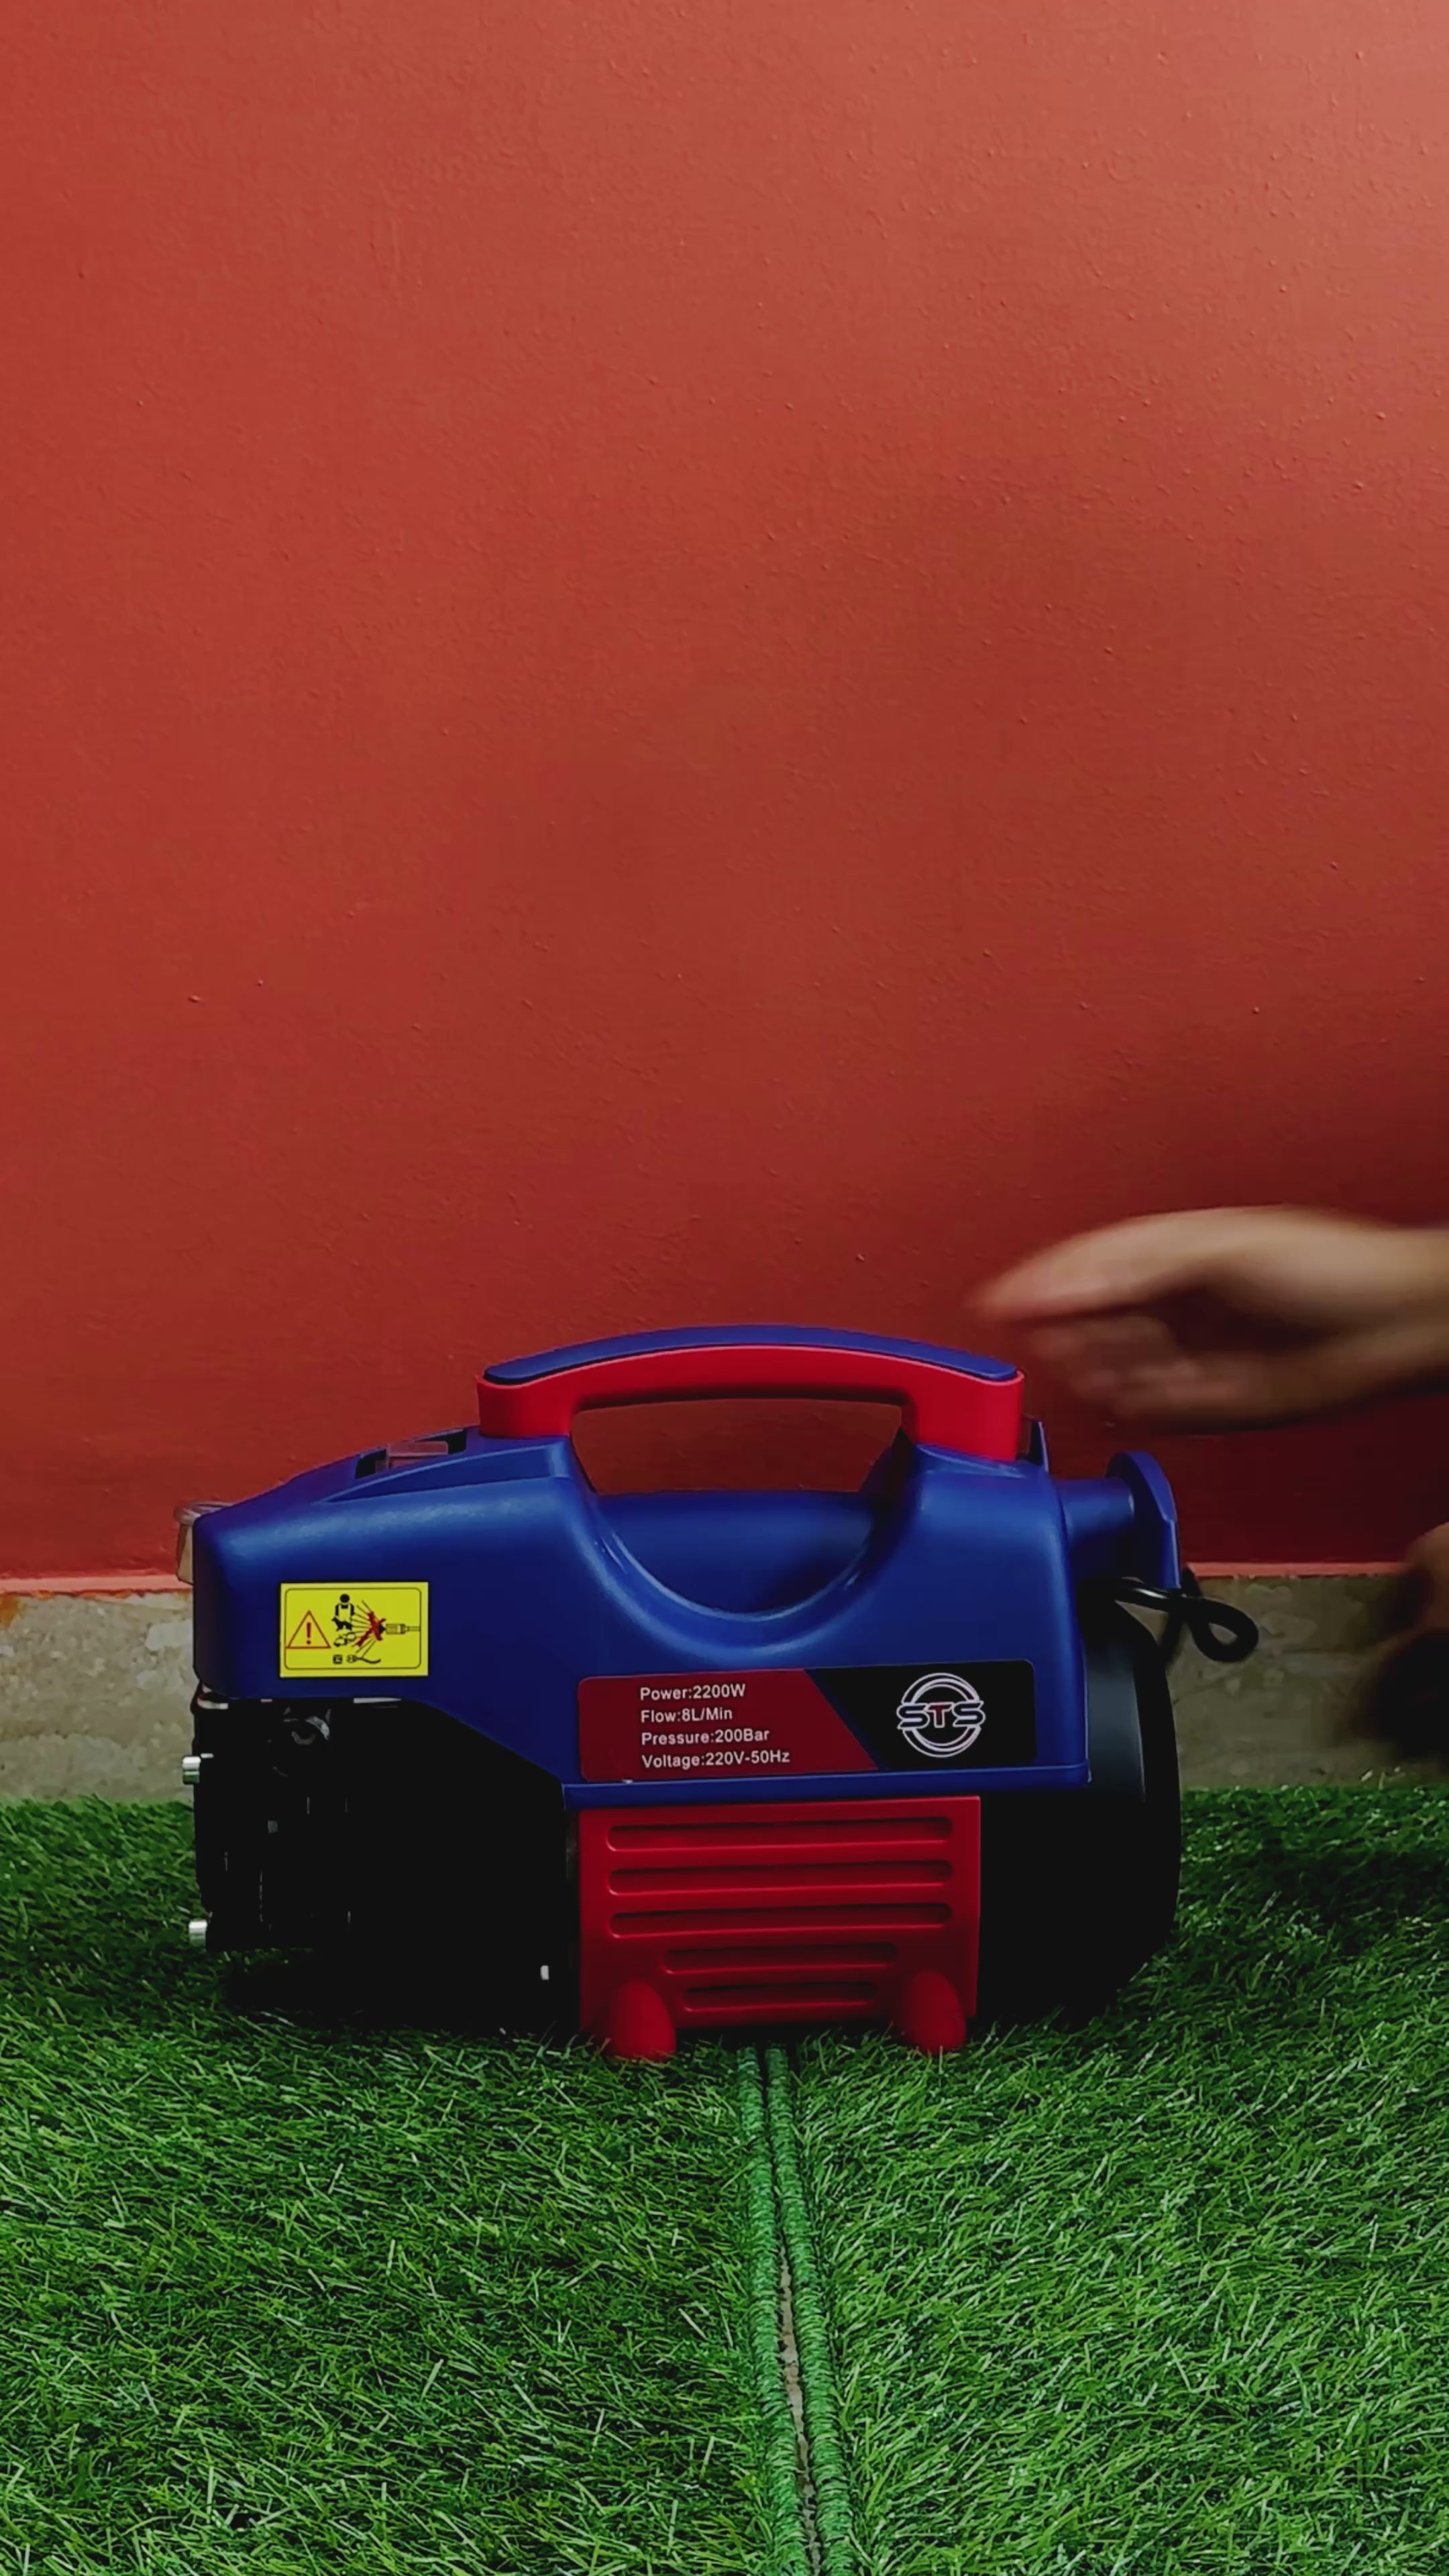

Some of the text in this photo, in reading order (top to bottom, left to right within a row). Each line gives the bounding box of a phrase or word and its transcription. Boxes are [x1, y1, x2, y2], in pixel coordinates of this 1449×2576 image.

[640, 1683, 746, 1701] Power:2200W
[641, 1707, 733, 1723] Flow:8L/Min
[896, 1700, 986, 1729] STS
[641, 1728, 769, 1746] Pressure:200Bar
[641, 1749, 790, 1770] Voltage:220V-50Hz
